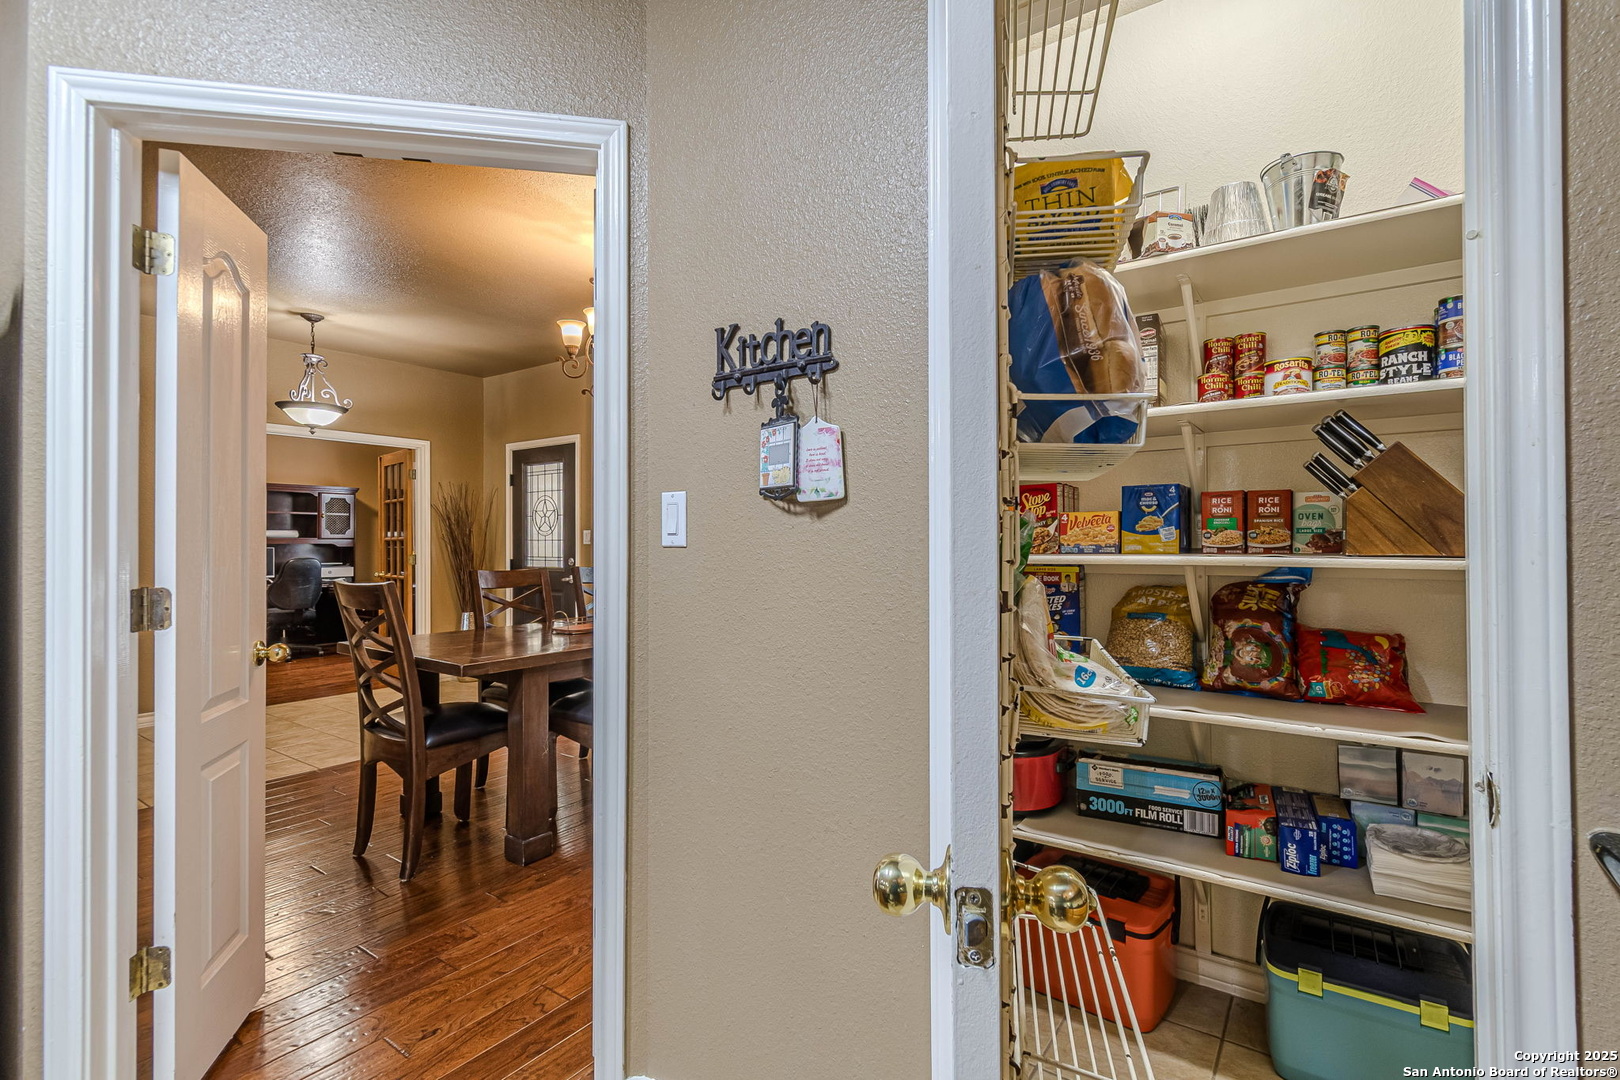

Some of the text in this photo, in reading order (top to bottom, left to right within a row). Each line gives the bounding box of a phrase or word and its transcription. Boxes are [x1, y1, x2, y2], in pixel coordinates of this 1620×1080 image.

[1024, 186, 1097, 211] THIN
[714, 317, 832, 374] Kitchen
[1235, 335, 1262, 344] Hormel
[1238, 342, 1257, 350] Chili
[1212, 346, 1230, 354] Chili
[1448, 353, 1464, 361] BLAC
[1274, 360, 1308, 372] Rosarita
[1381, 350, 1428, 368] RANCH
[1380, 363, 1432, 380] STYLE
[1204, 382, 1224, 390] Chili
[1388, 375, 1420, 385] BEANS
[1022, 492, 1052, 508] Stove
[1070, 514, 1112, 531] Velveeta
[1315, 685, 1323, 694] GF
[1135, 808, 1183, 824] FILM ROLL
[1286, 842, 1299, 869] Ziploc
